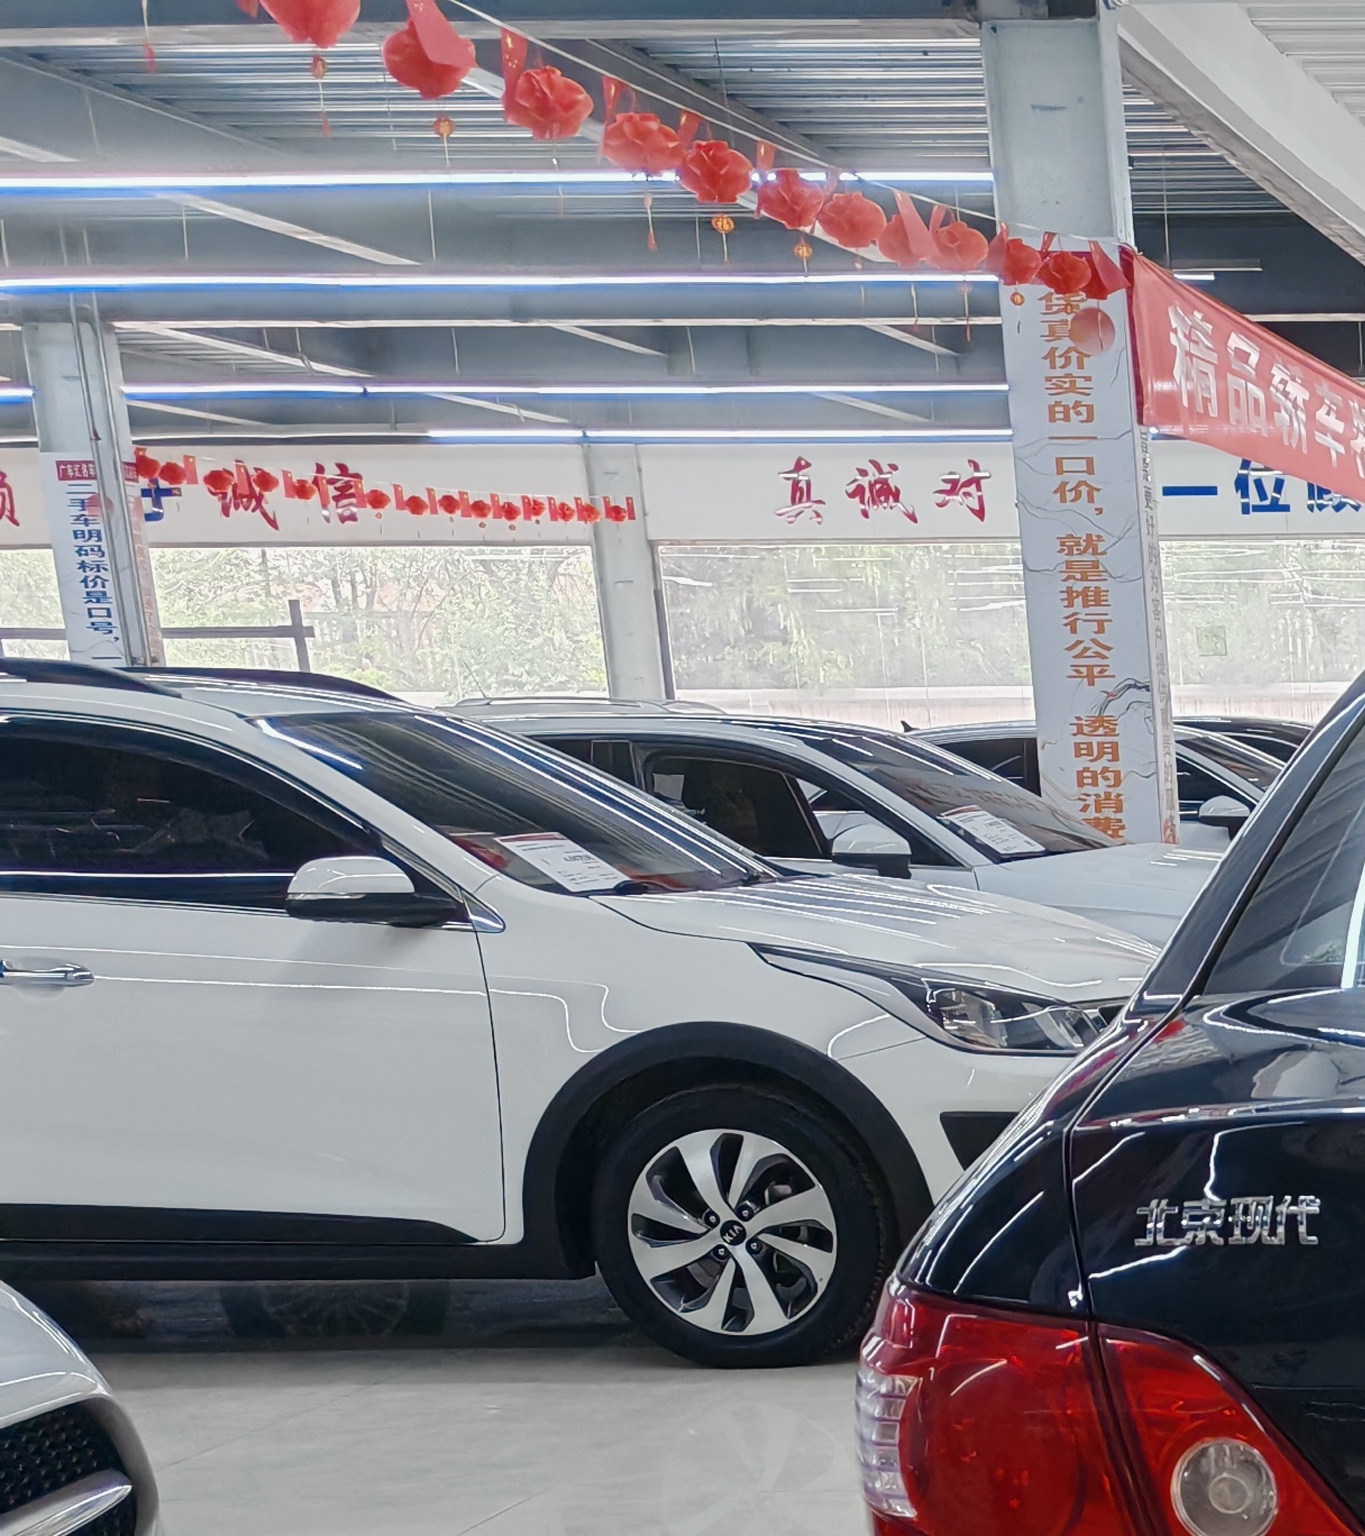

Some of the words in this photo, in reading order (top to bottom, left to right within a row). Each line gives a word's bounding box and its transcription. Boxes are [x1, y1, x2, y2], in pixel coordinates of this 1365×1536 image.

[723, 1225, 743, 1244] KIA
[1134, 1196, 1321, 1246] 北京现代
